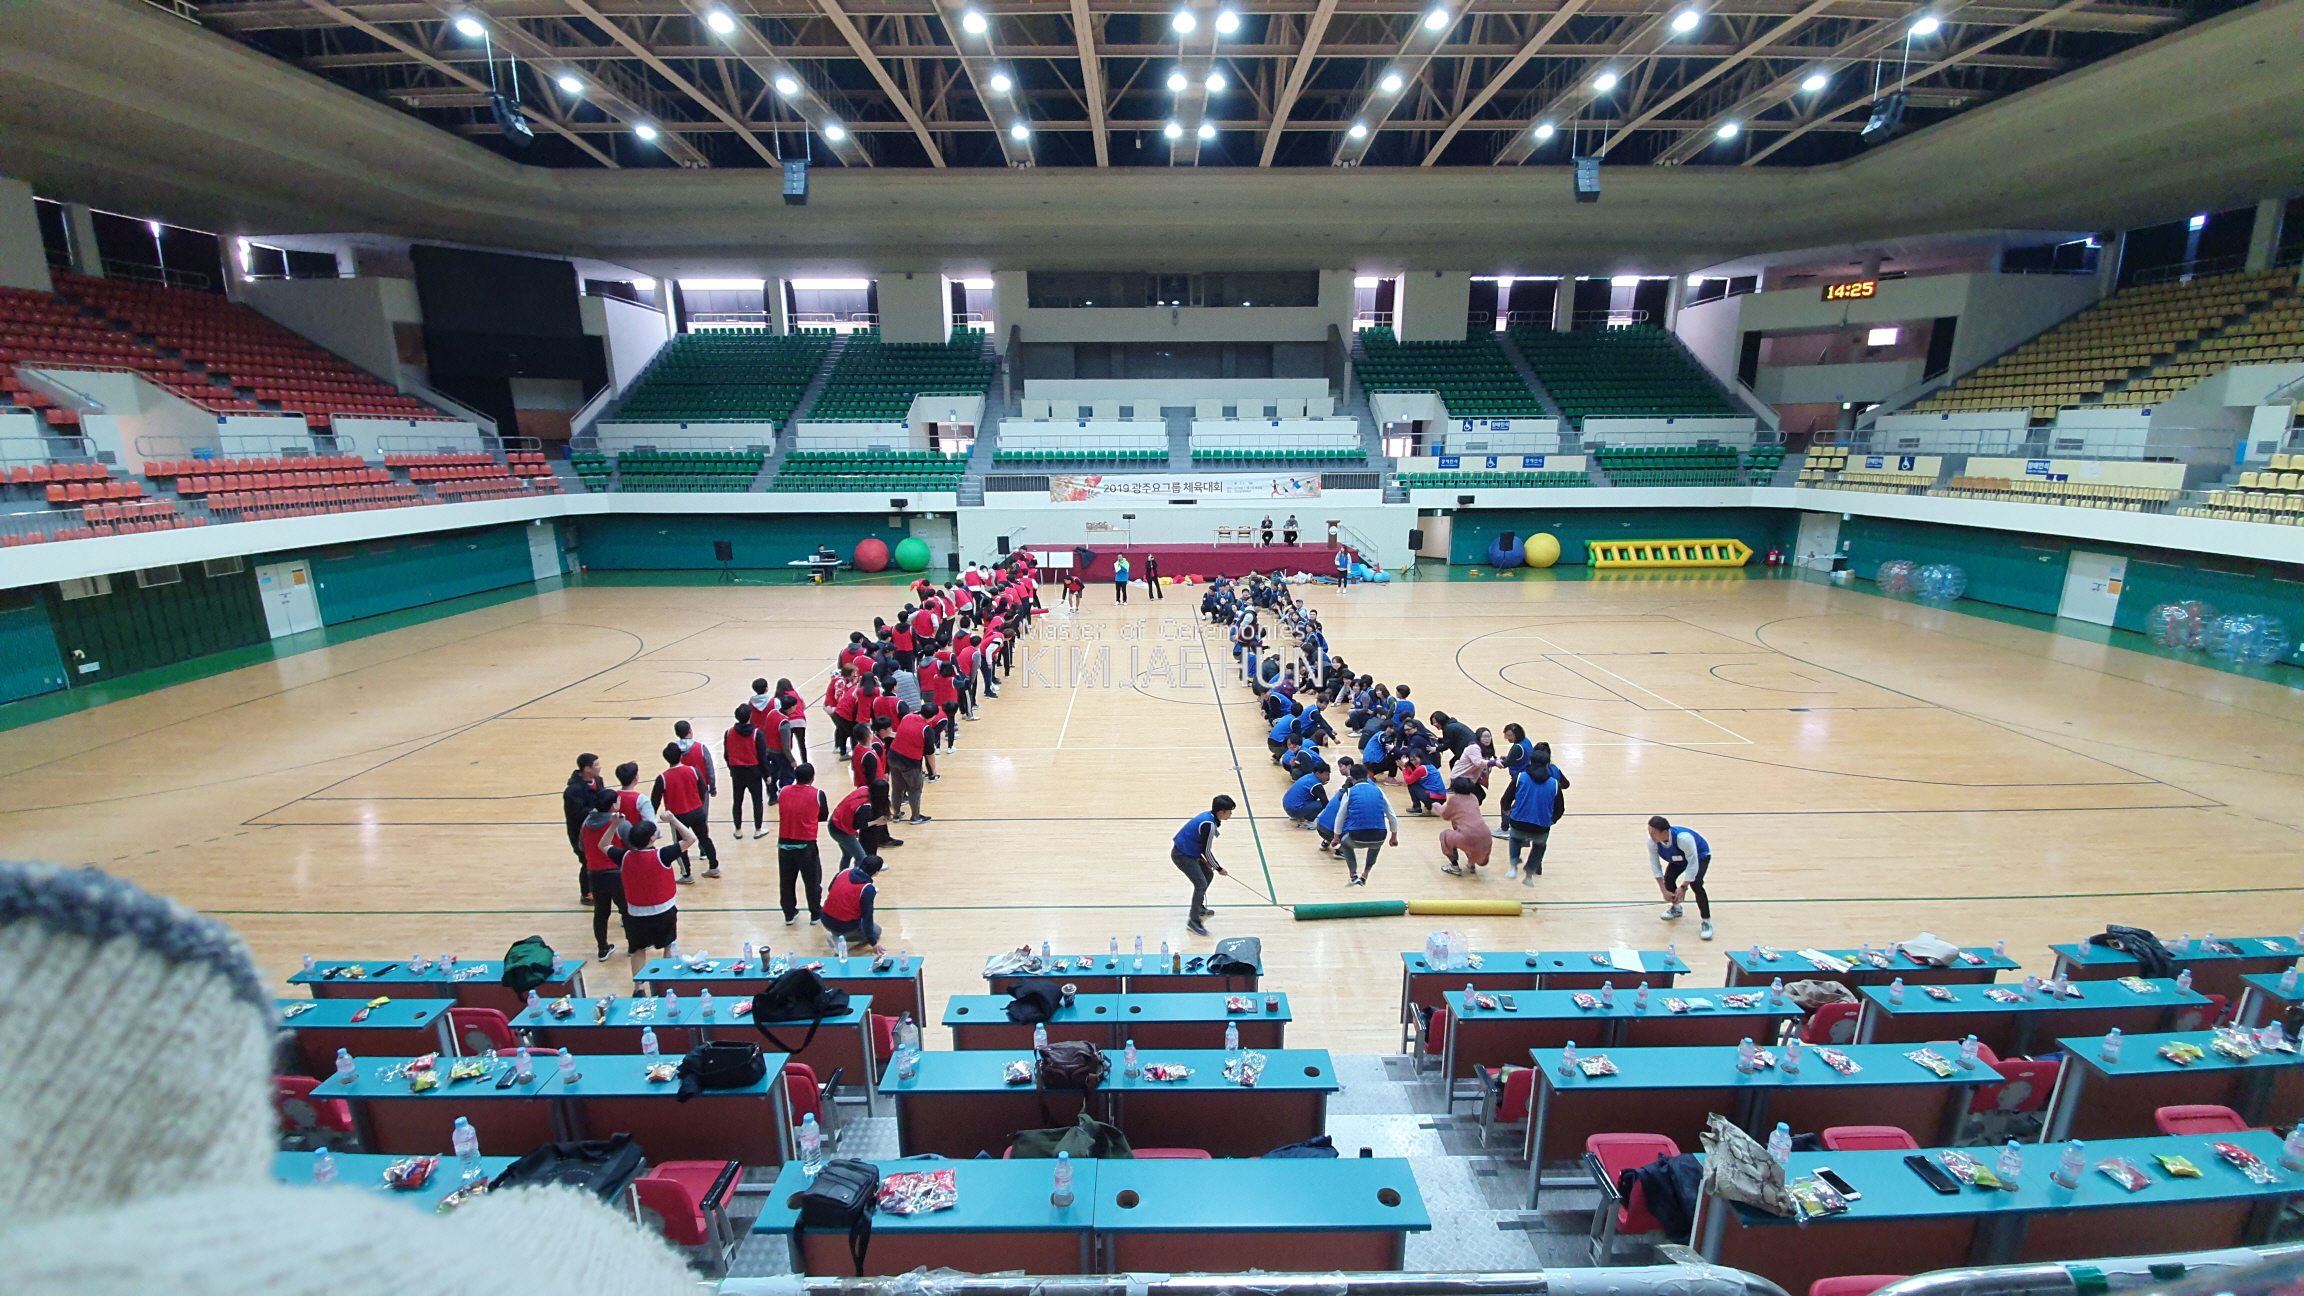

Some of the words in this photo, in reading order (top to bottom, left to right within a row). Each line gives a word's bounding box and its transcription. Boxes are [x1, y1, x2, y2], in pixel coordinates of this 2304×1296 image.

[1827, 281, 1874, 299] 14:25
[1103, 483, 1130, 493] 2019
[1131, 482, 1181, 494] 광주요그룹
[1183, 481, 1223, 493] 체육대회
